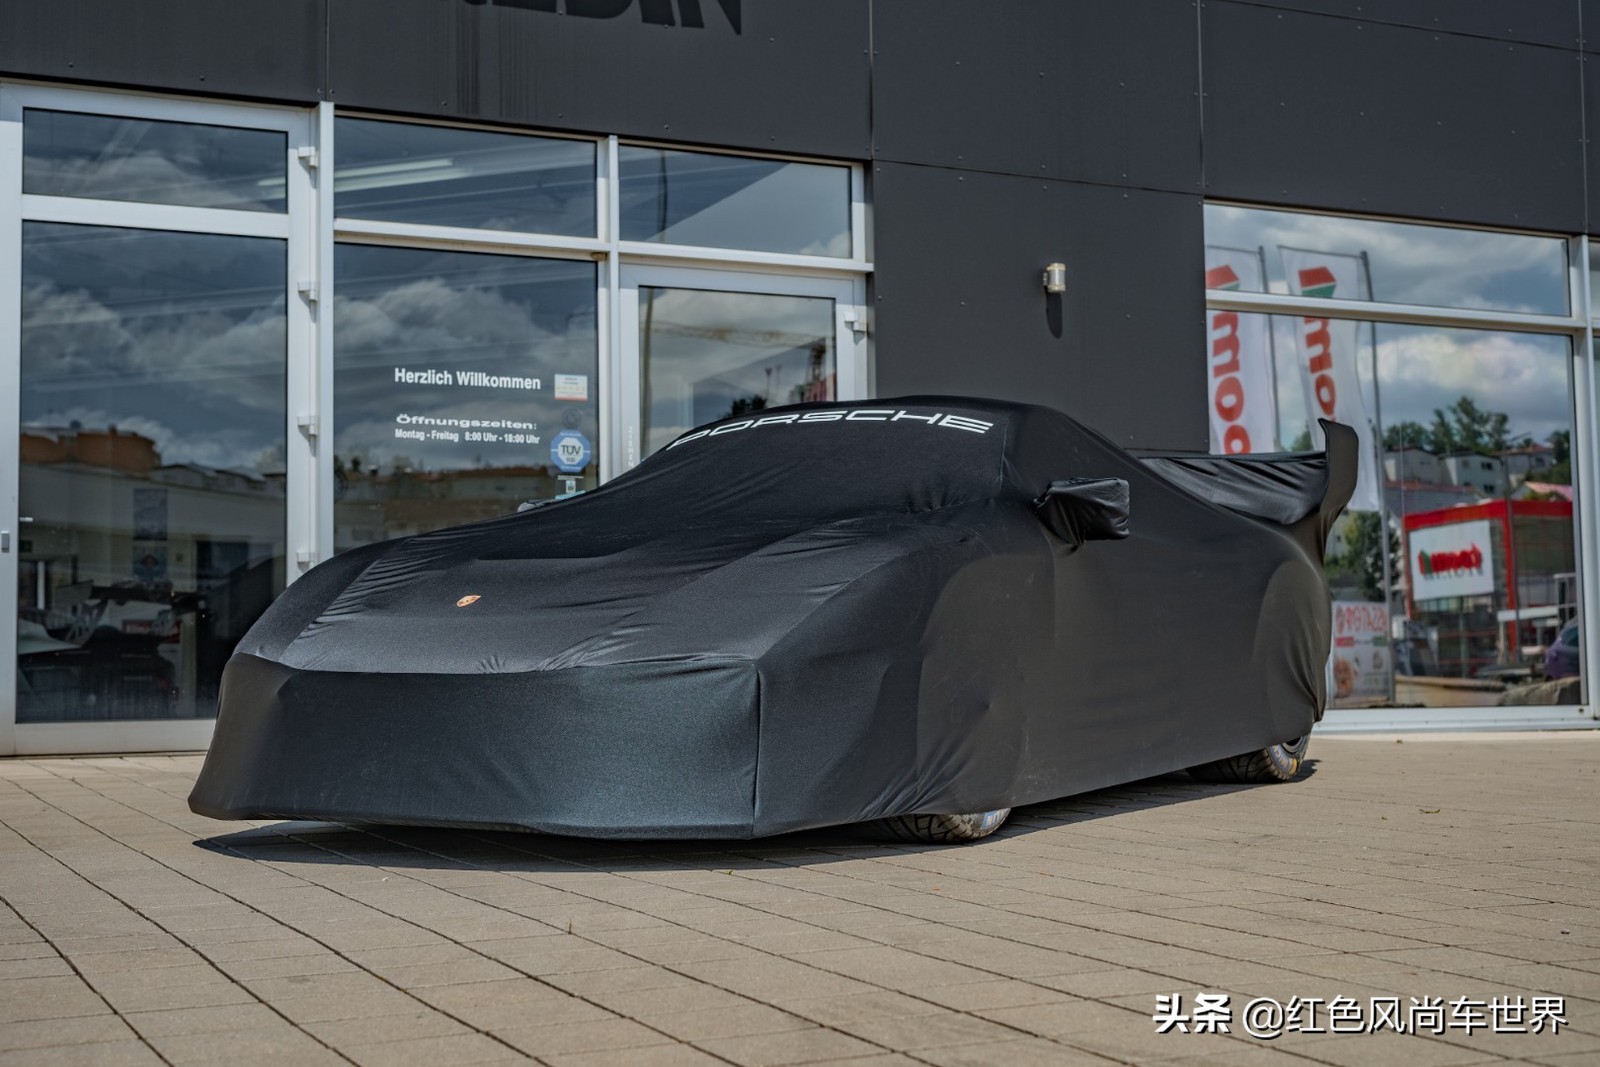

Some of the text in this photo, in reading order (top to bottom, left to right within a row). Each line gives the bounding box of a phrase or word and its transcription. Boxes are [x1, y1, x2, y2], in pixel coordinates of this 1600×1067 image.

[395, 367, 541, 390] Herzlich Willkommen
[396, 414, 537, 430] Öffnungszeiten:
[666, 410, 993, 450] PORSCHE
[395, 428, 425, 441] Montag
[431, 430, 459, 443] Freitag
[465, 431, 481, 441] 8:00
[483, 432, 498, 442] Uhr
[504, 433, 525, 443] 18:00
[526, 434, 541, 444] Uhr
